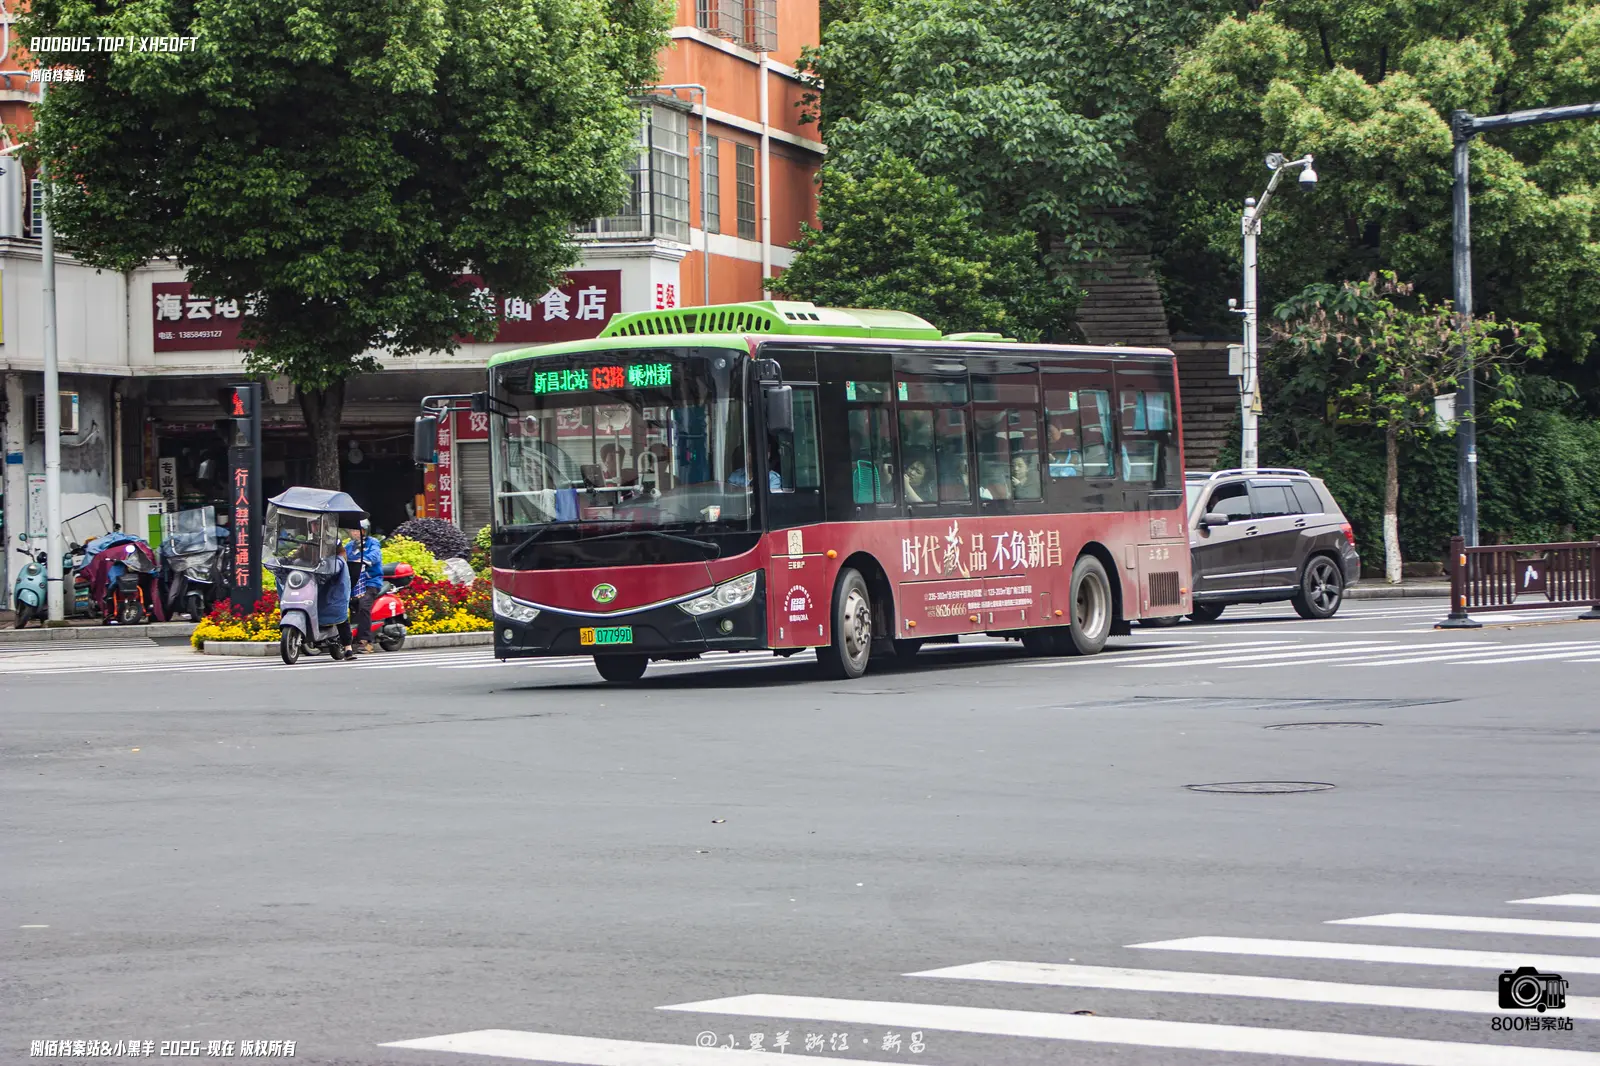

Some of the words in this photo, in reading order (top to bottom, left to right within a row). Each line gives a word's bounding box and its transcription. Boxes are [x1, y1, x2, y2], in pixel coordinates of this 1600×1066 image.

[534, 369, 589, 394] 新昌北站
[591, 366, 625, 390] G3路
[628, 363, 672, 387] 嵊州新
[438, 428, 451, 523] 新鲜饺子
[234, 468, 250, 587] 行人禁止通行
[991, 529, 1063, 571] 不负新昌
